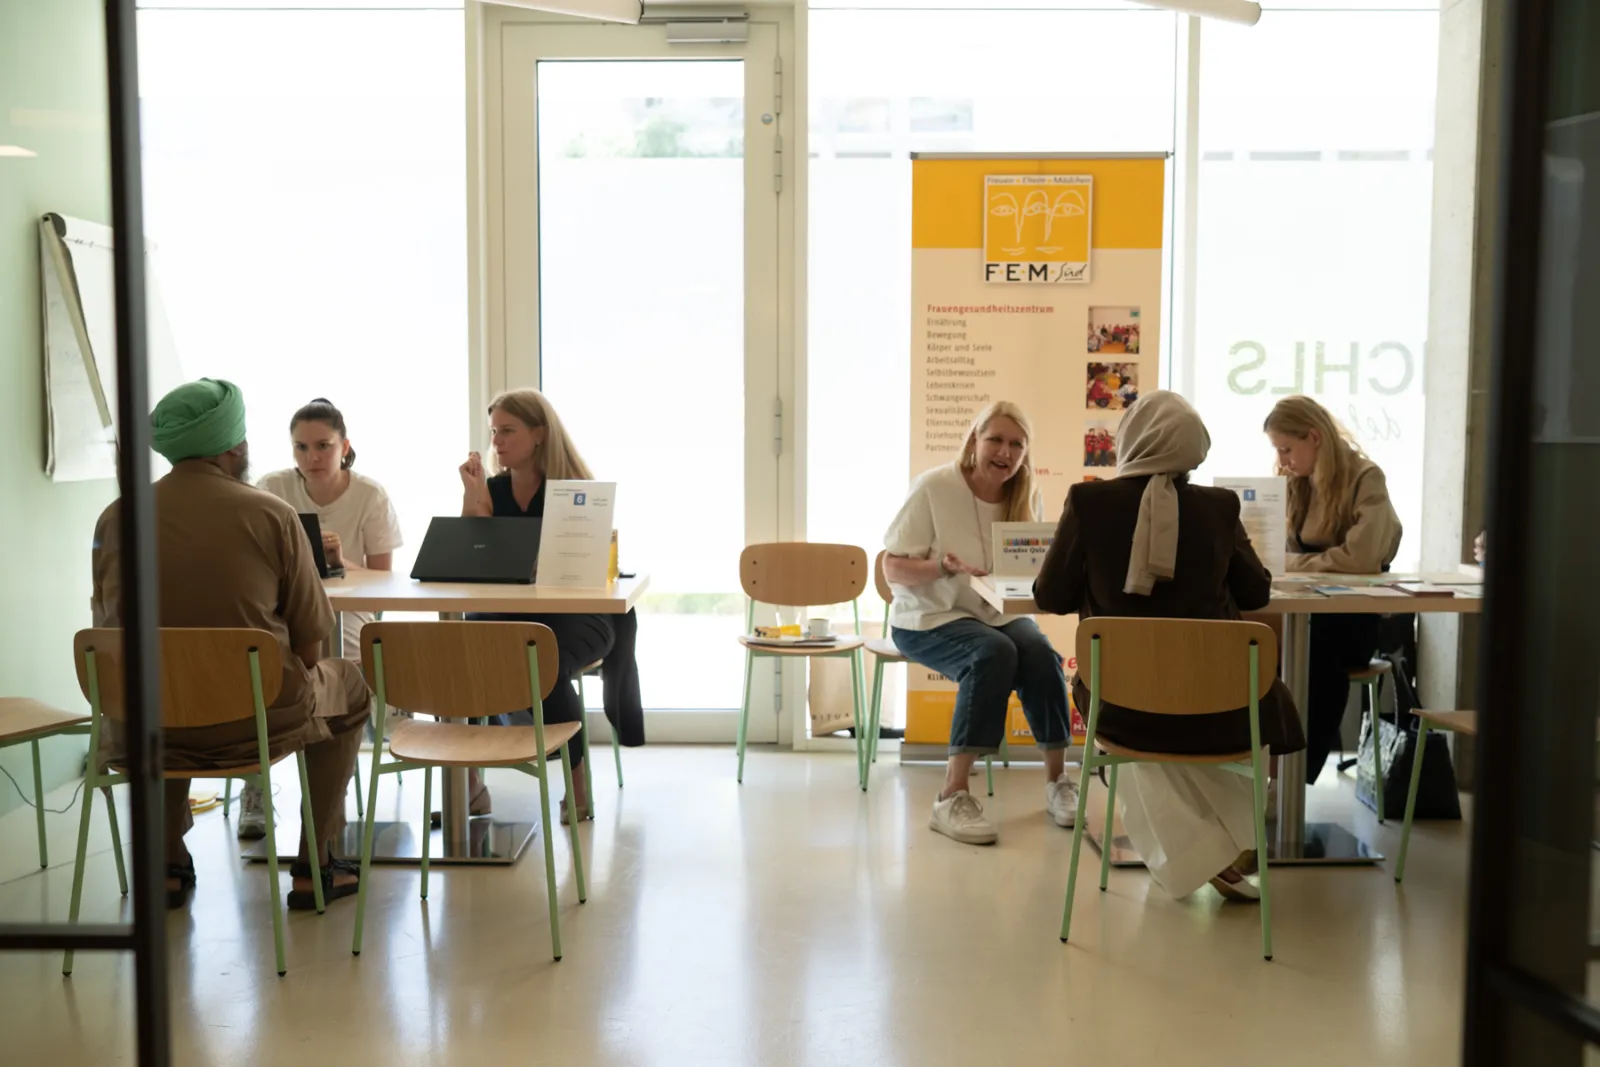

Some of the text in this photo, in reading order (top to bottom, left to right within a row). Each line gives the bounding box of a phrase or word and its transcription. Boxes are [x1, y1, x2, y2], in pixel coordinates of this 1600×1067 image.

[1055, 262, 1087, 282] Süd
[926, 304, 1054, 315] Frauengesundheitszentrum
[926, 317, 967, 328] Ernährung
[926, 330, 967, 341] Bewegung
[926, 342, 993, 353] Körper und Seele
[926, 355, 976, 366] Arbeitsalltag
[925, 393, 991, 403] Schwangerschaft
